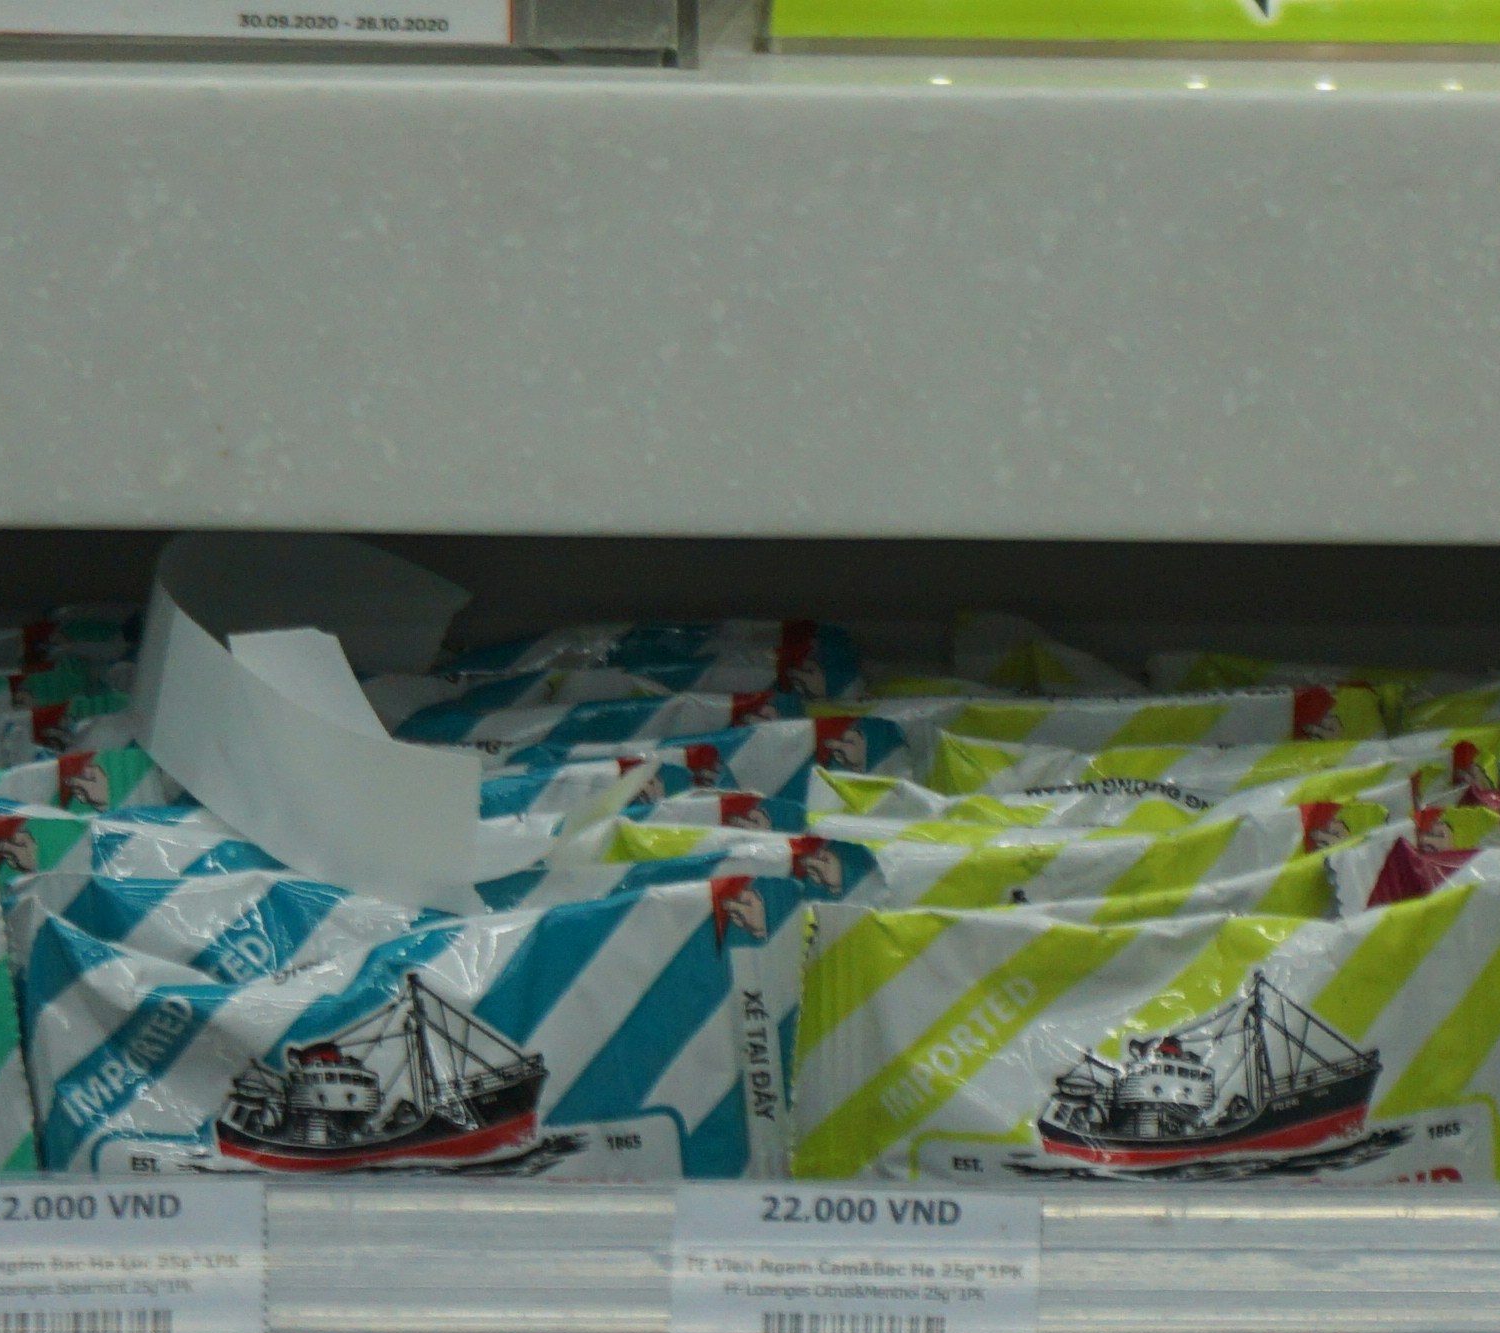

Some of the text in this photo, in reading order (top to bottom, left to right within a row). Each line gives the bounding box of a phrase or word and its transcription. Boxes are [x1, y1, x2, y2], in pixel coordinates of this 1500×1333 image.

[238, 14, 340, 31] 30.09.2020
[1428, 1121, 1461, 1140] 1865
[953, 1155, 984, 1174] EST.
[108, 1194, 181, 1220] VND
[762, 1196, 961, 1226] 22.000 VND
